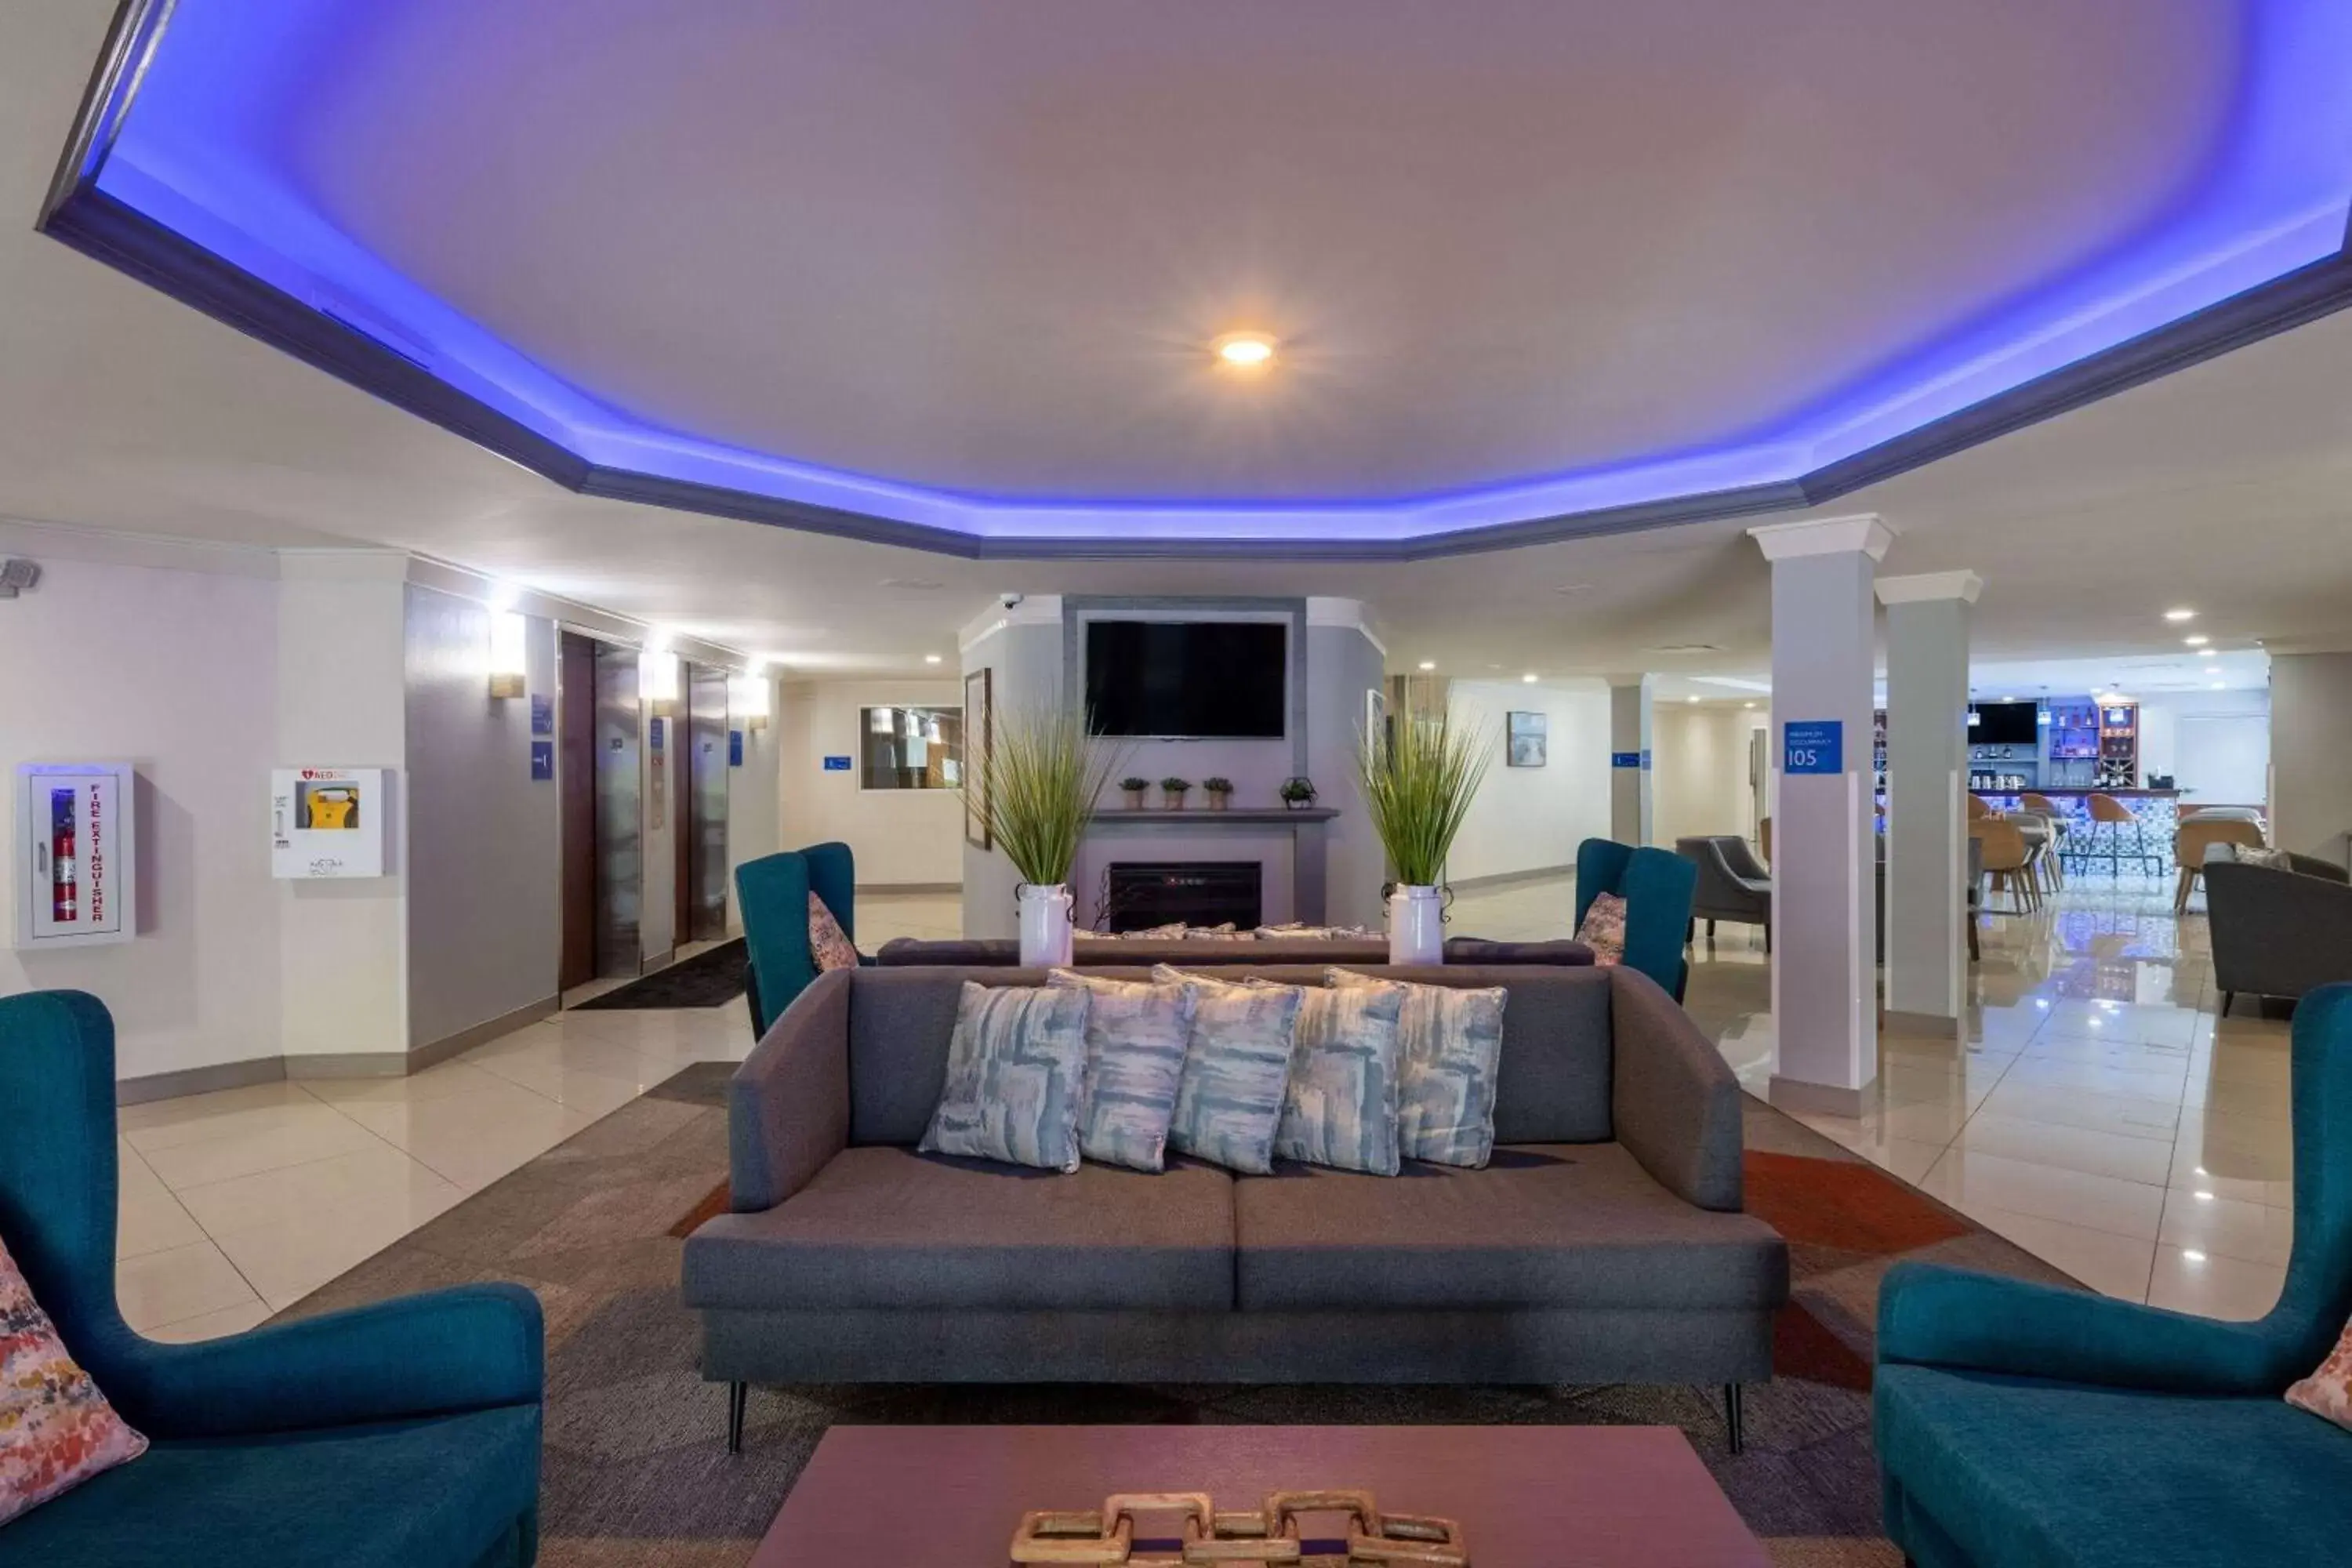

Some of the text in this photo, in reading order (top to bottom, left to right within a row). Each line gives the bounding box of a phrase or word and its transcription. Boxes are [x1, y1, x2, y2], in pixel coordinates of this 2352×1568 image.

[1789, 749, 1817, 766] 105
[90, 784, 103, 921] FIRE EXTINGUISHER
